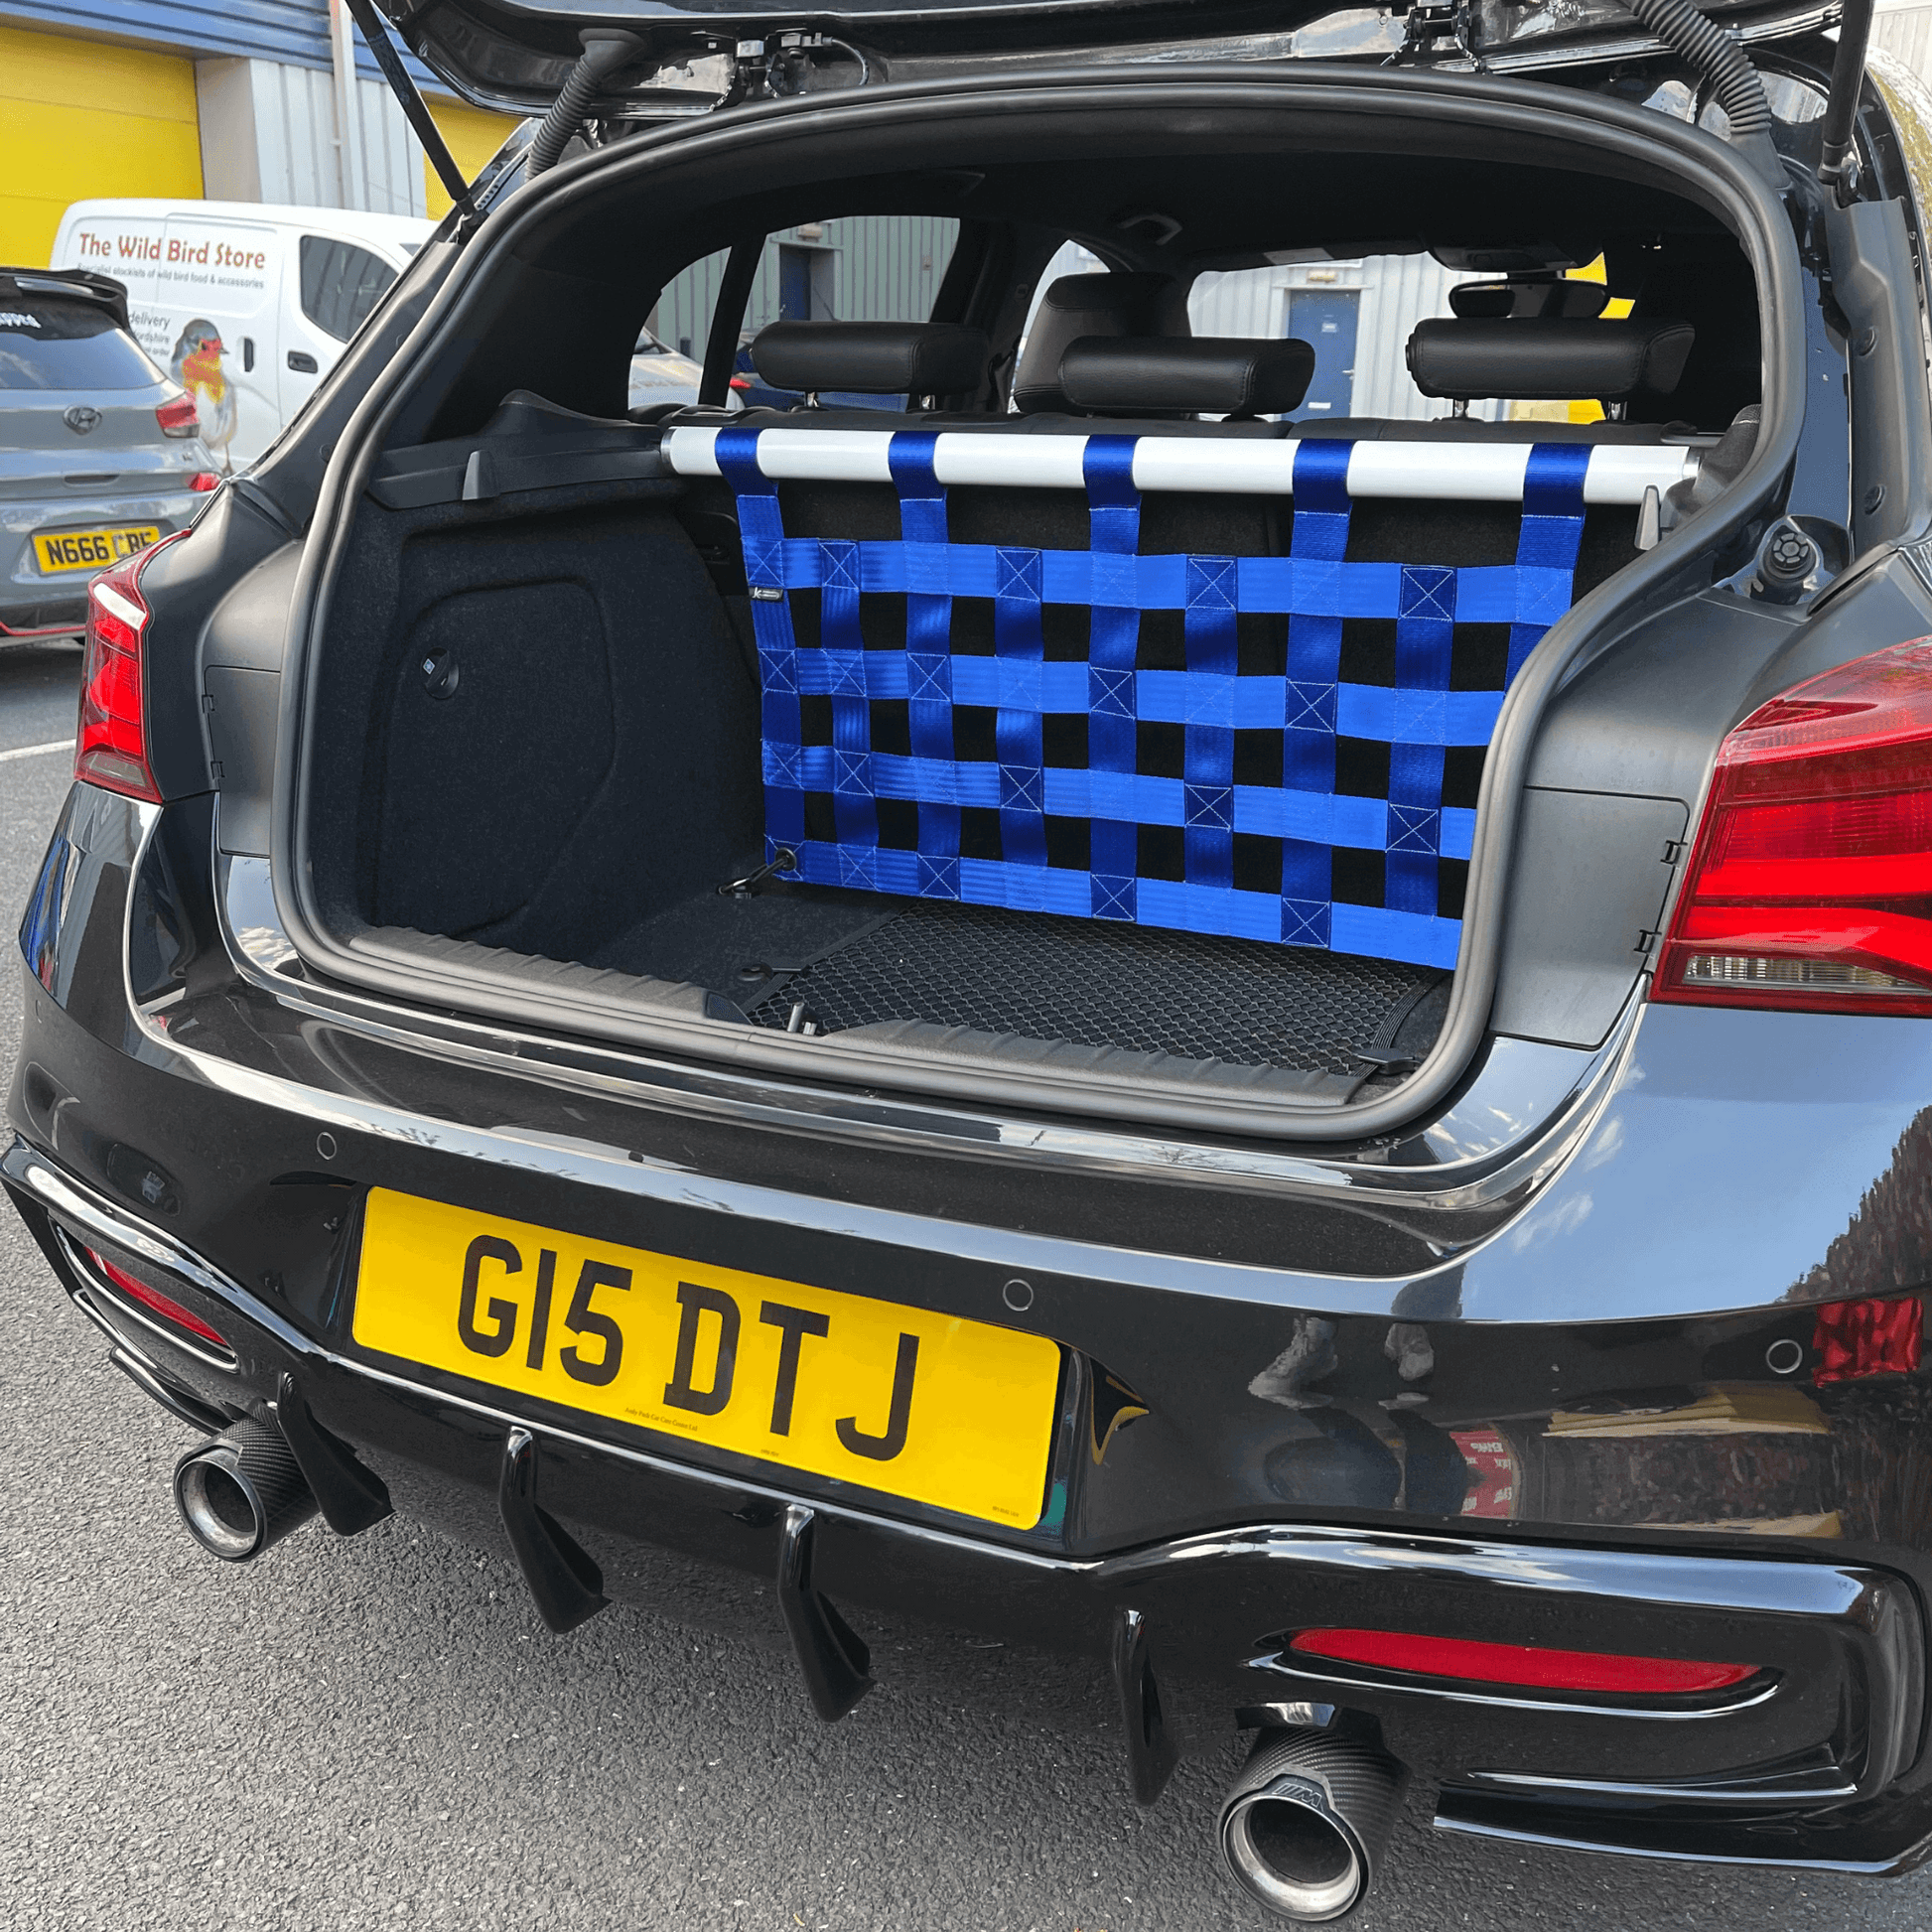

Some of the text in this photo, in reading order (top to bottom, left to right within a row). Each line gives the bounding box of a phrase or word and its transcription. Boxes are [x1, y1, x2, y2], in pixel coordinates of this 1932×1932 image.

[79, 232, 265, 269] The Wild Bird Store
[173, 270, 190, 282] bird
[190, 271, 208, 284] food
[209, 274, 215, 285] &
[217, 277, 264, 289] accessories
[45, 535, 110, 565] N666
[458, 1234, 633, 1387] G15
